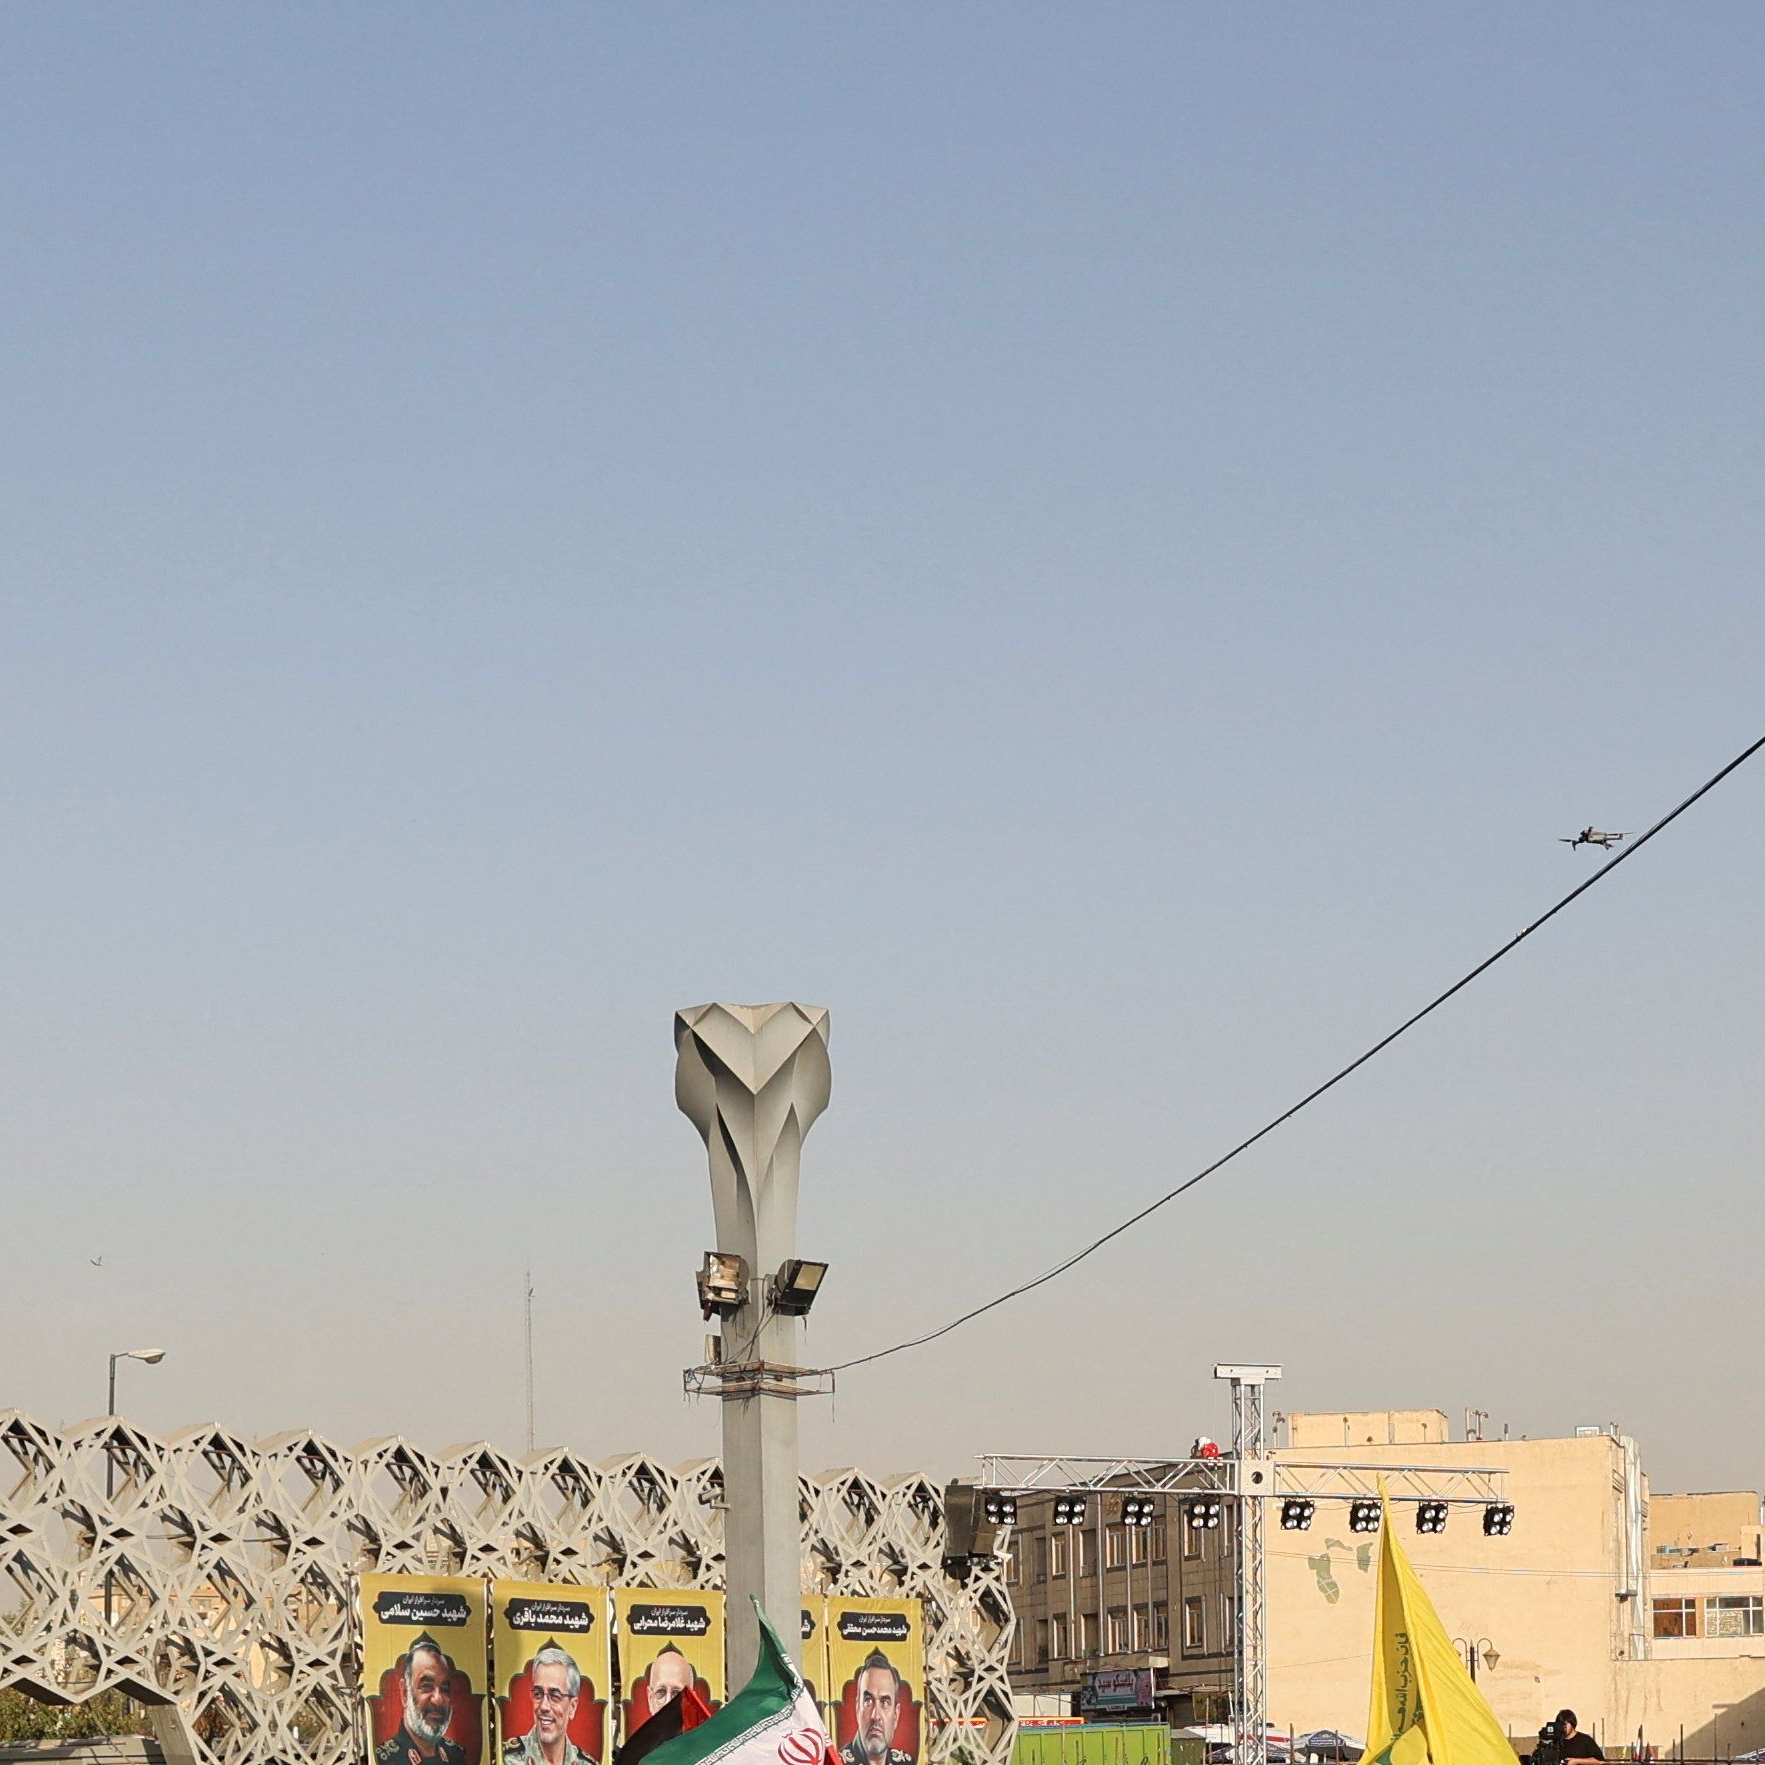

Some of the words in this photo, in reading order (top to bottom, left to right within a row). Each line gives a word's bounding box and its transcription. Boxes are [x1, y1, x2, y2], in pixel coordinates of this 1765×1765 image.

[380, 1603, 410, 1620] سلامی
[411, 1607, 440, 1621] حسین
[441, 1605, 467, 1622] شهید
[512, 1607, 536, 1627] باقری
[537, 1612, 563, 1625] محمد
[563, 1611, 589, 1629] شهید
[633, 1615, 658, 1631] محرابی
[658, 1616, 685, 1631] غلامرضا
[685, 1616, 706, 1632] شهید
[861, 1624, 876, 1636] حسن
[876, 1625, 892, 1634] محمد
[892, 1624, 907, 1636] شهید
